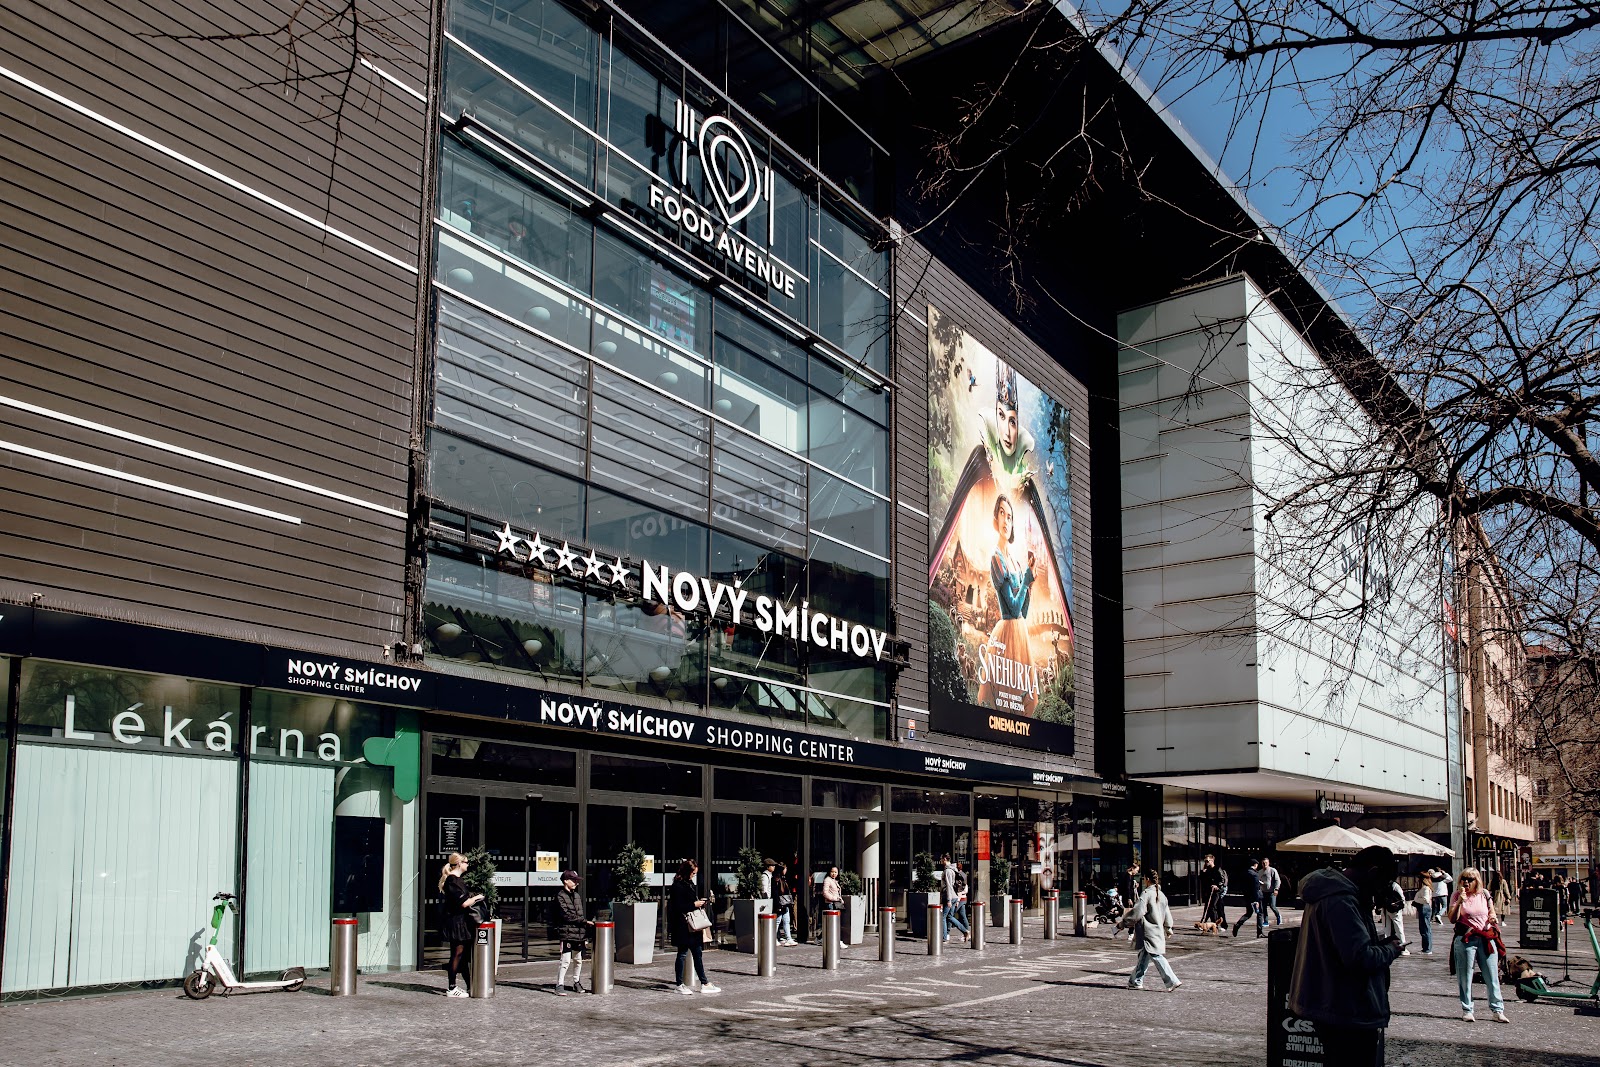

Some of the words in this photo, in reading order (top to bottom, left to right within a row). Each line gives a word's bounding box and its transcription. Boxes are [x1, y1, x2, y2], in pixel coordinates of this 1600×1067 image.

[650, 184, 714, 243] FOOD
[718, 231, 796, 299] AVENUE
[713, 492, 783, 521] OFFEE
[642, 559, 748, 624] NOVÝ
[755, 595, 887, 662] SMÍCHOV
[288, 658, 340, 681] NOVÝ
[344, 667, 422, 692] SMÍCHOV
[288, 676, 331, 690] SHOPPING
[334, 682, 365, 694] CENTER
[978, 643, 1040, 700] SNĚHURKA
[64, 694, 342, 761] Lékárna
[540, 699, 603, 728] NOVÝ
[608, 709, 695, 740] SMÍCHOV
[707, 725, 793, 755] SHOPPING
[800, 739, 854, 762] CENTER
[989, 715, 1016, 734] CINEMA
[1015, 723, 1030, 736] CITY
[925, 757, 941, 767] NOVÝ
[942, 759, 967, 770] SMÍCHOV
[1286, 1043, 1304, 1053] STAV
[1288, 1035, 1312, 1044] ODPAD
